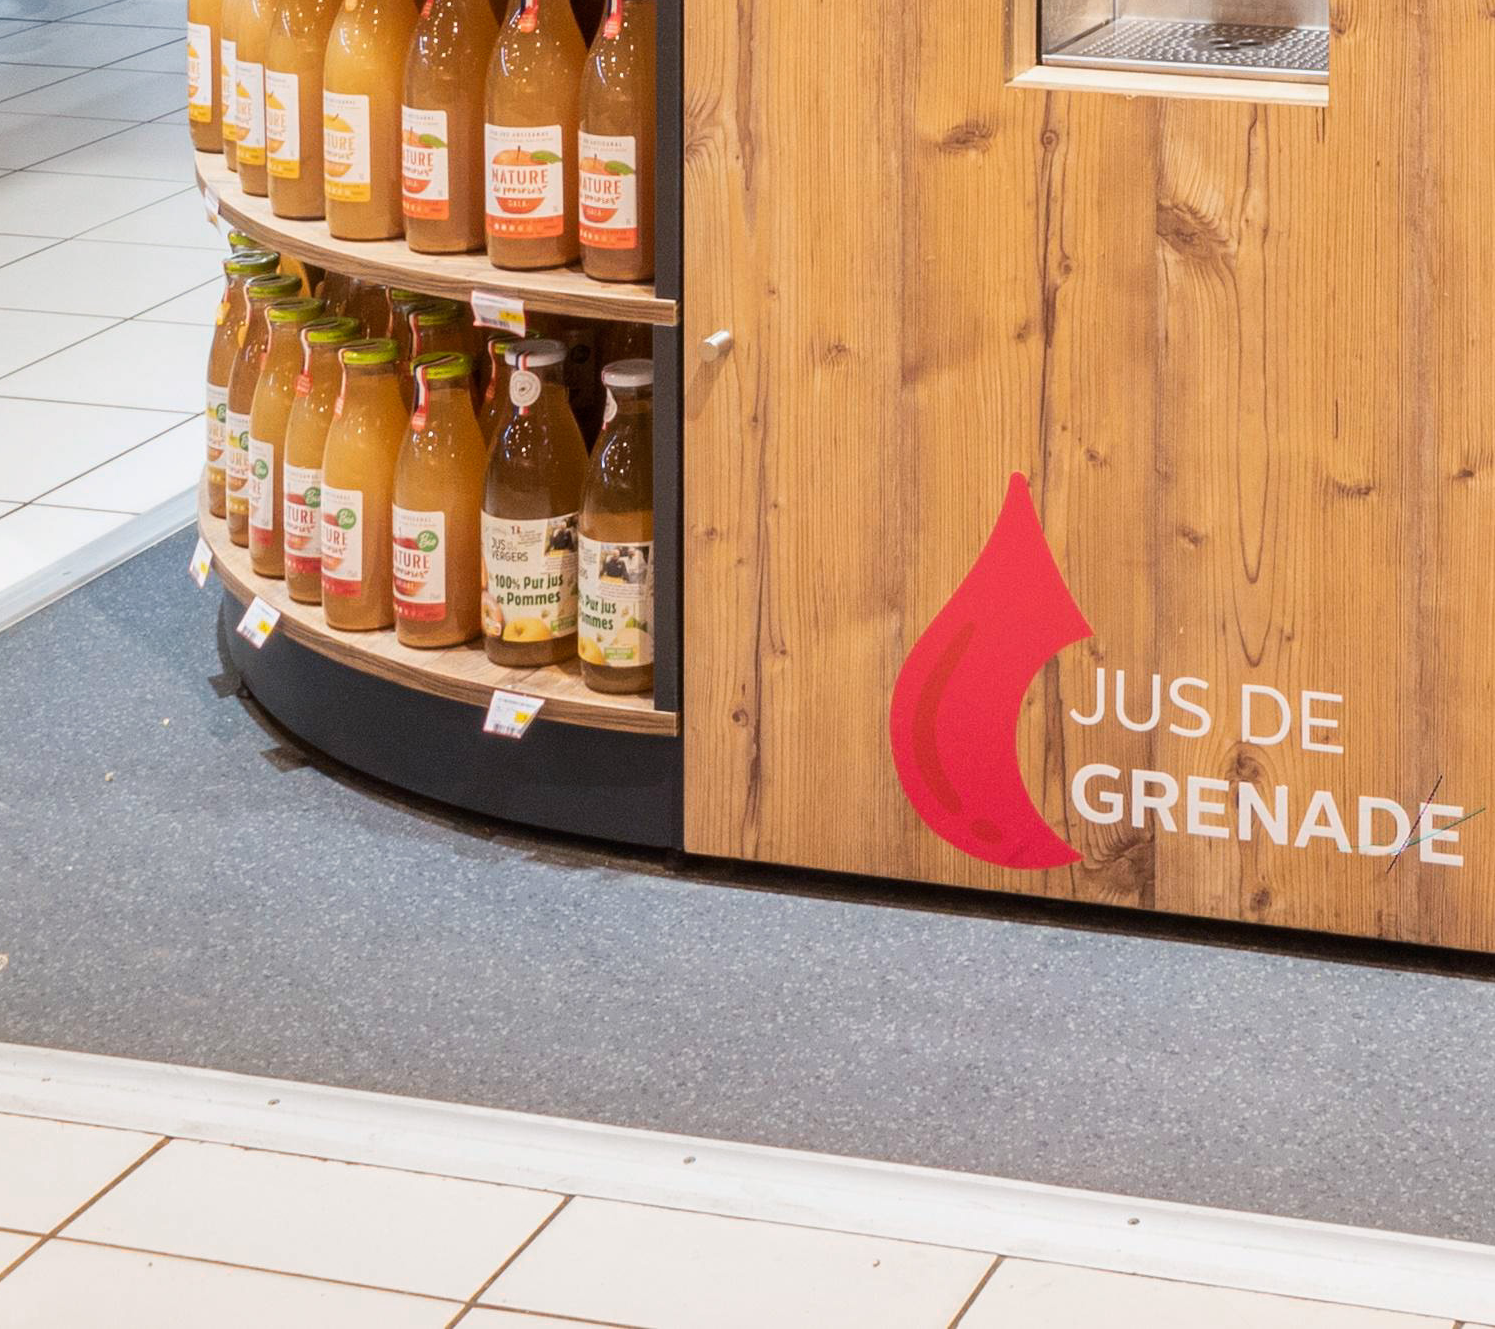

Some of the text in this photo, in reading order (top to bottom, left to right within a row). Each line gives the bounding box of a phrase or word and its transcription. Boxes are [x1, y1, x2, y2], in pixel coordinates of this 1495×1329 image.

[492, 169, 549, 185] NATURE
[495, 574, 521, 589] 100%
[524, 576, 544, 589] Pur
[507, 591, 562, 606] Pommes
[1069, 667, 1344, 755] JUS DE
[1071, 763, 1465, 868] GRENADE
